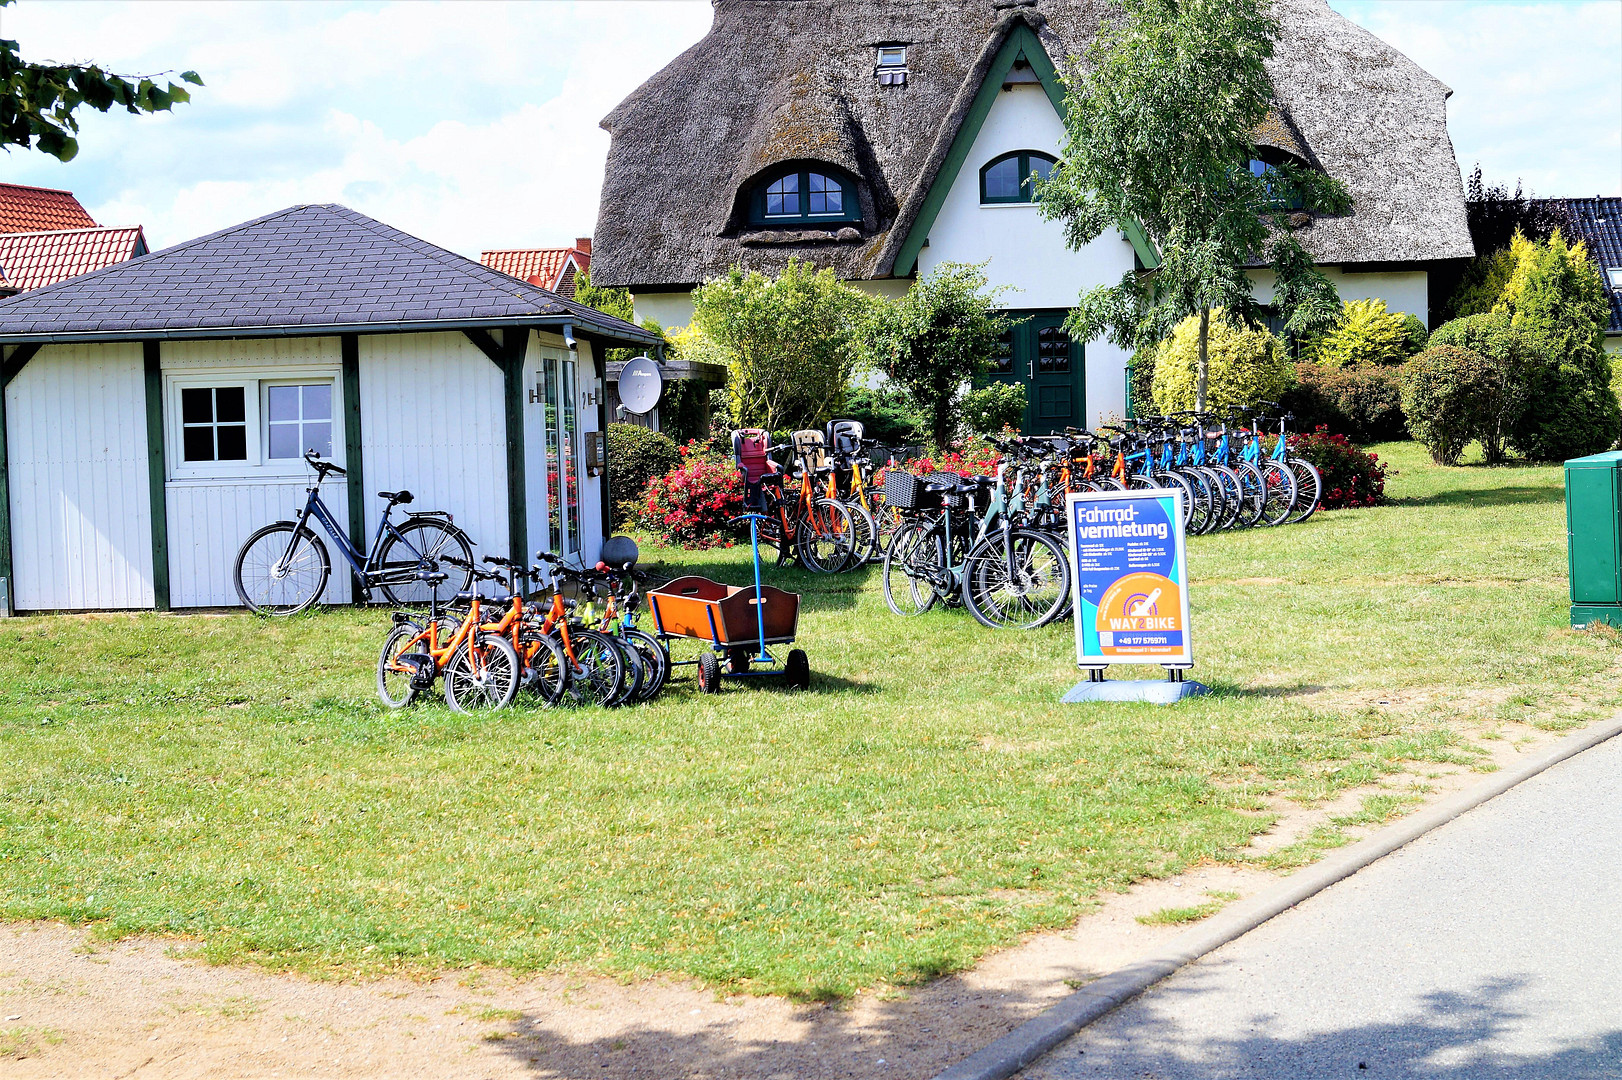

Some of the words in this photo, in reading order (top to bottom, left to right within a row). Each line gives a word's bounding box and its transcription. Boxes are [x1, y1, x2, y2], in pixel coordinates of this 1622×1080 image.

[1077, 504, 1140, 523] Fahrrad-
[1079, 521, 1168, 540] vermietung
[1109, 617, 1176, 630] WAY2BIKE
[1118, 637, 1132, 645] +49
[1132, 637, 1142, 645] 177
